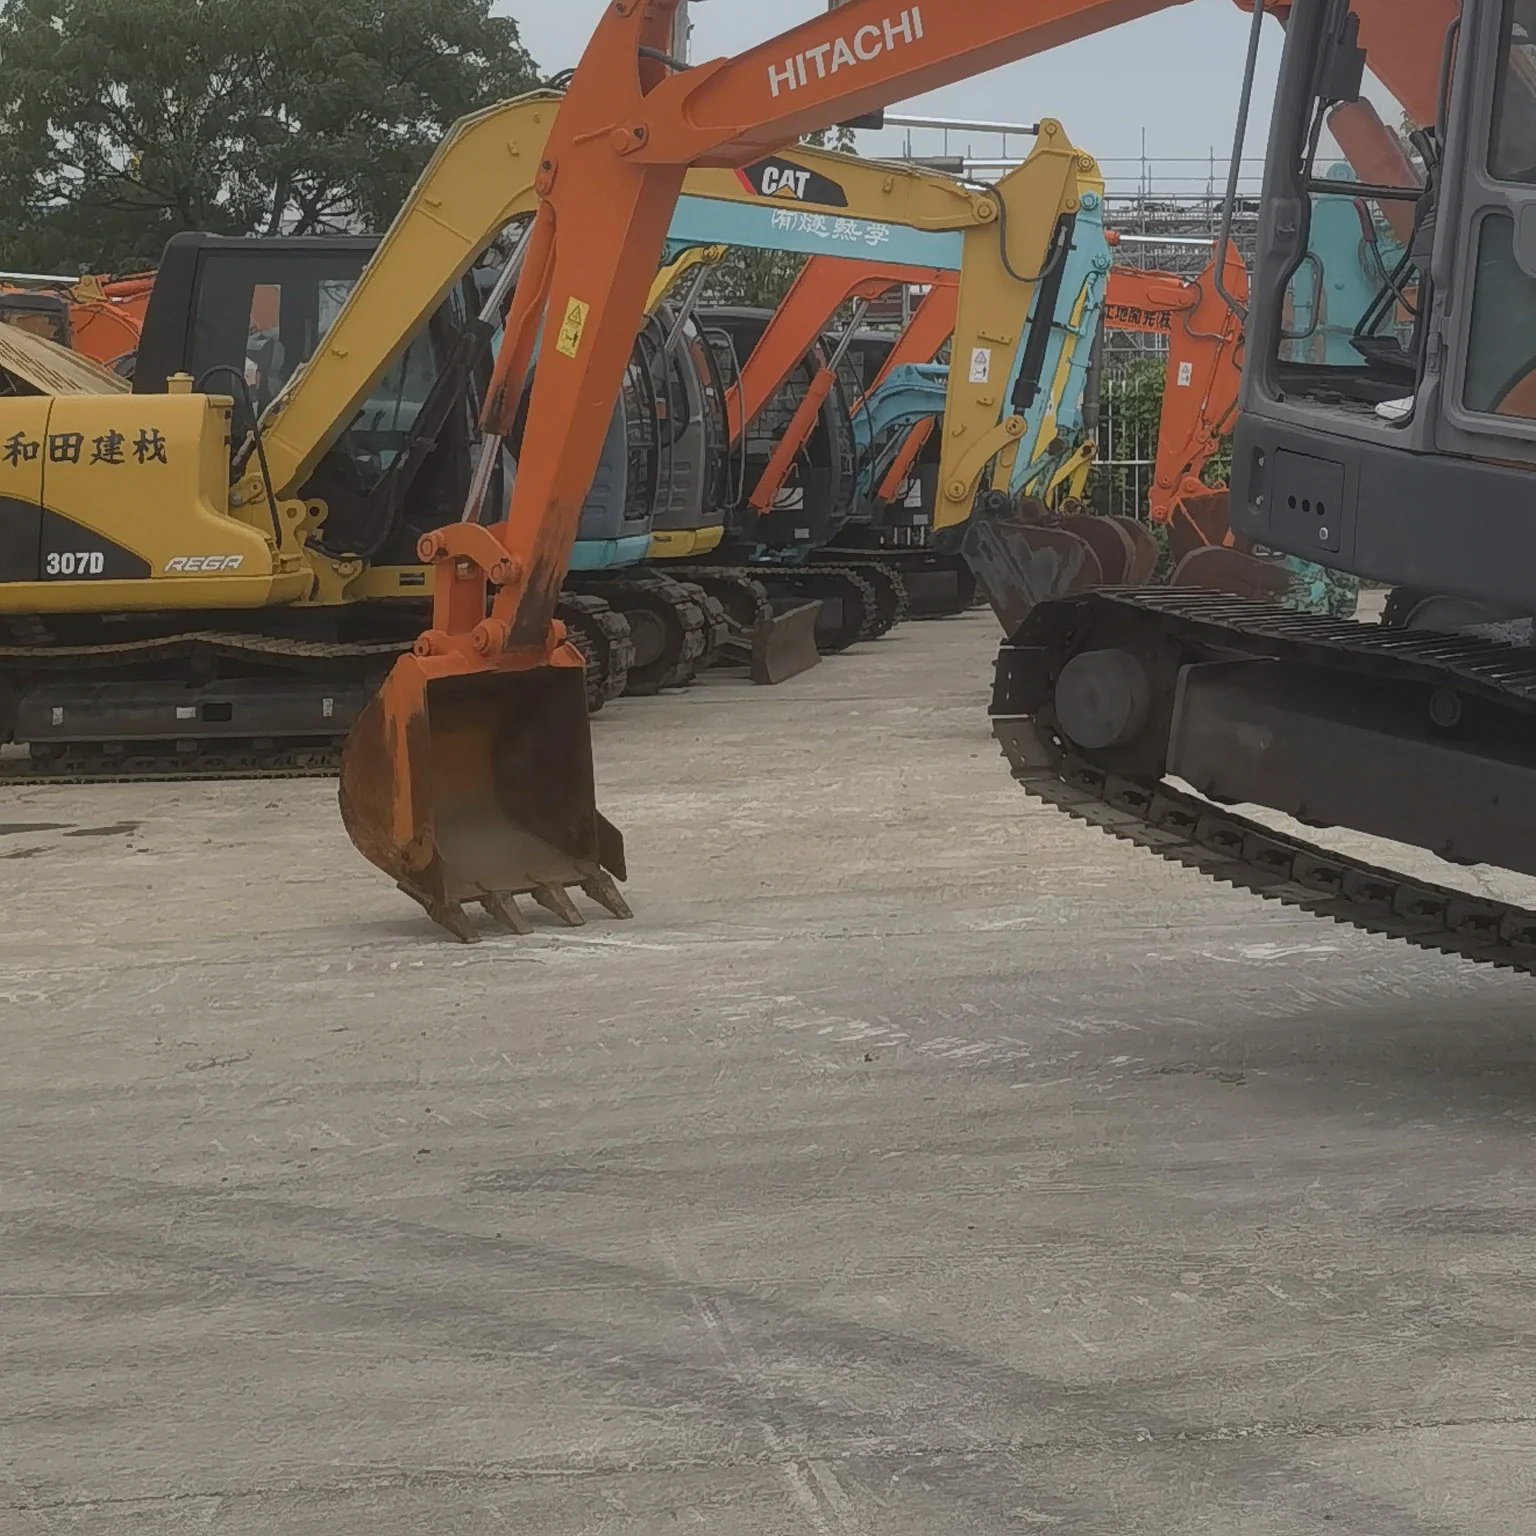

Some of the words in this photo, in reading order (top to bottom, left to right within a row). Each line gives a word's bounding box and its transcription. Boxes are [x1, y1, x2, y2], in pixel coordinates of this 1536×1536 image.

[768, 6, 924, 98] HITACHI
[761, 166, 810, 199] CAT
[46, 552, 104, 575] 307D
[164, 555, 244, 572] REGA
